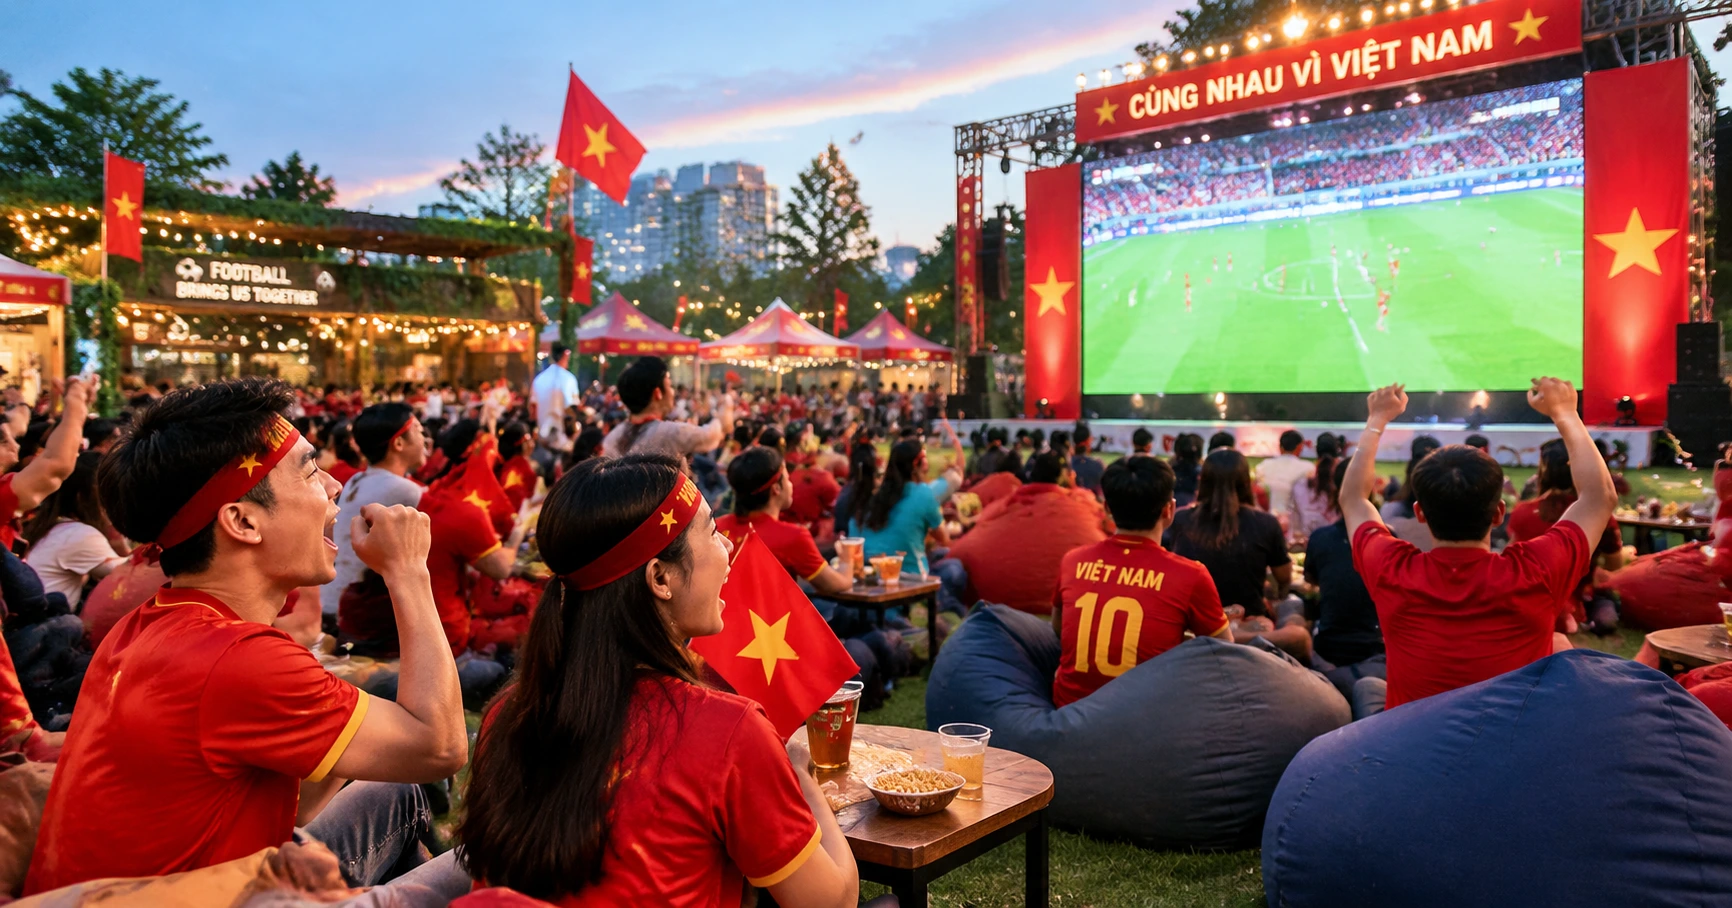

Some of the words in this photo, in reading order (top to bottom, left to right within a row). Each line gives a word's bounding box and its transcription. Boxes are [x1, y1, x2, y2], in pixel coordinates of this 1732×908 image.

[1206, 65, 1284, 105] NHAU
[1291, 50, 1321, 88] VÌ
[1330, 38, 1401, 80] VIỆT
[1411, 20, 1493, 65] NAM
[209, 261, 292, 285] FOOTBALL
[175, 281, 229, 300] BRINGS
[231, 285, 251, 302] US
[252, 286, 318, 306] TOGETHER
[1075, 559, 1116, 583] VIỆT
[1117, 567, 1165, 591] NAM
[1074, 592, 1144, 677] 10
